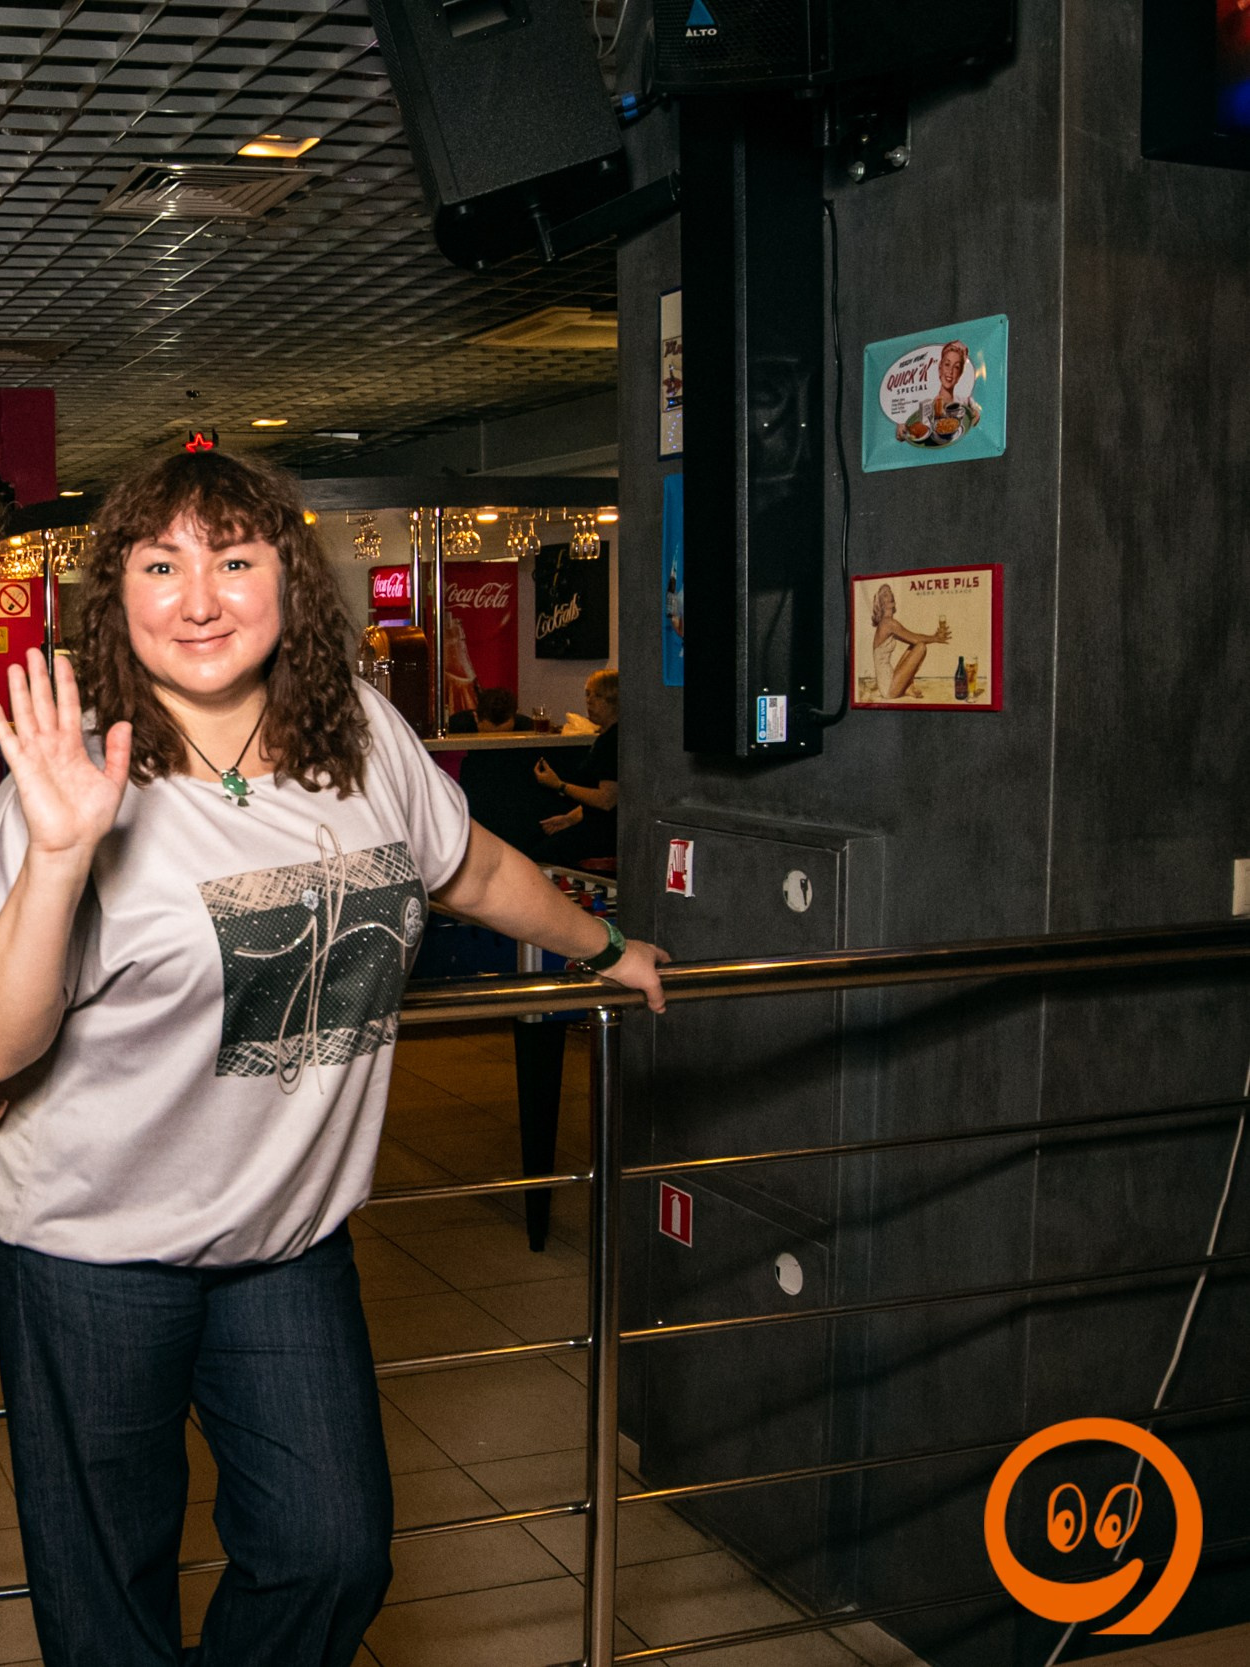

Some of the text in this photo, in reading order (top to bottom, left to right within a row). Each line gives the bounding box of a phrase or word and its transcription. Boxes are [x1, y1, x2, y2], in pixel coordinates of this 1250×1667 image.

[685, 28, 718, 37] ALTO
[887, 367, 918, 392] QUICK
[897, 384, 928, 395] SPECIAL
[910, 576, 980, 591] ANCRE PILS
